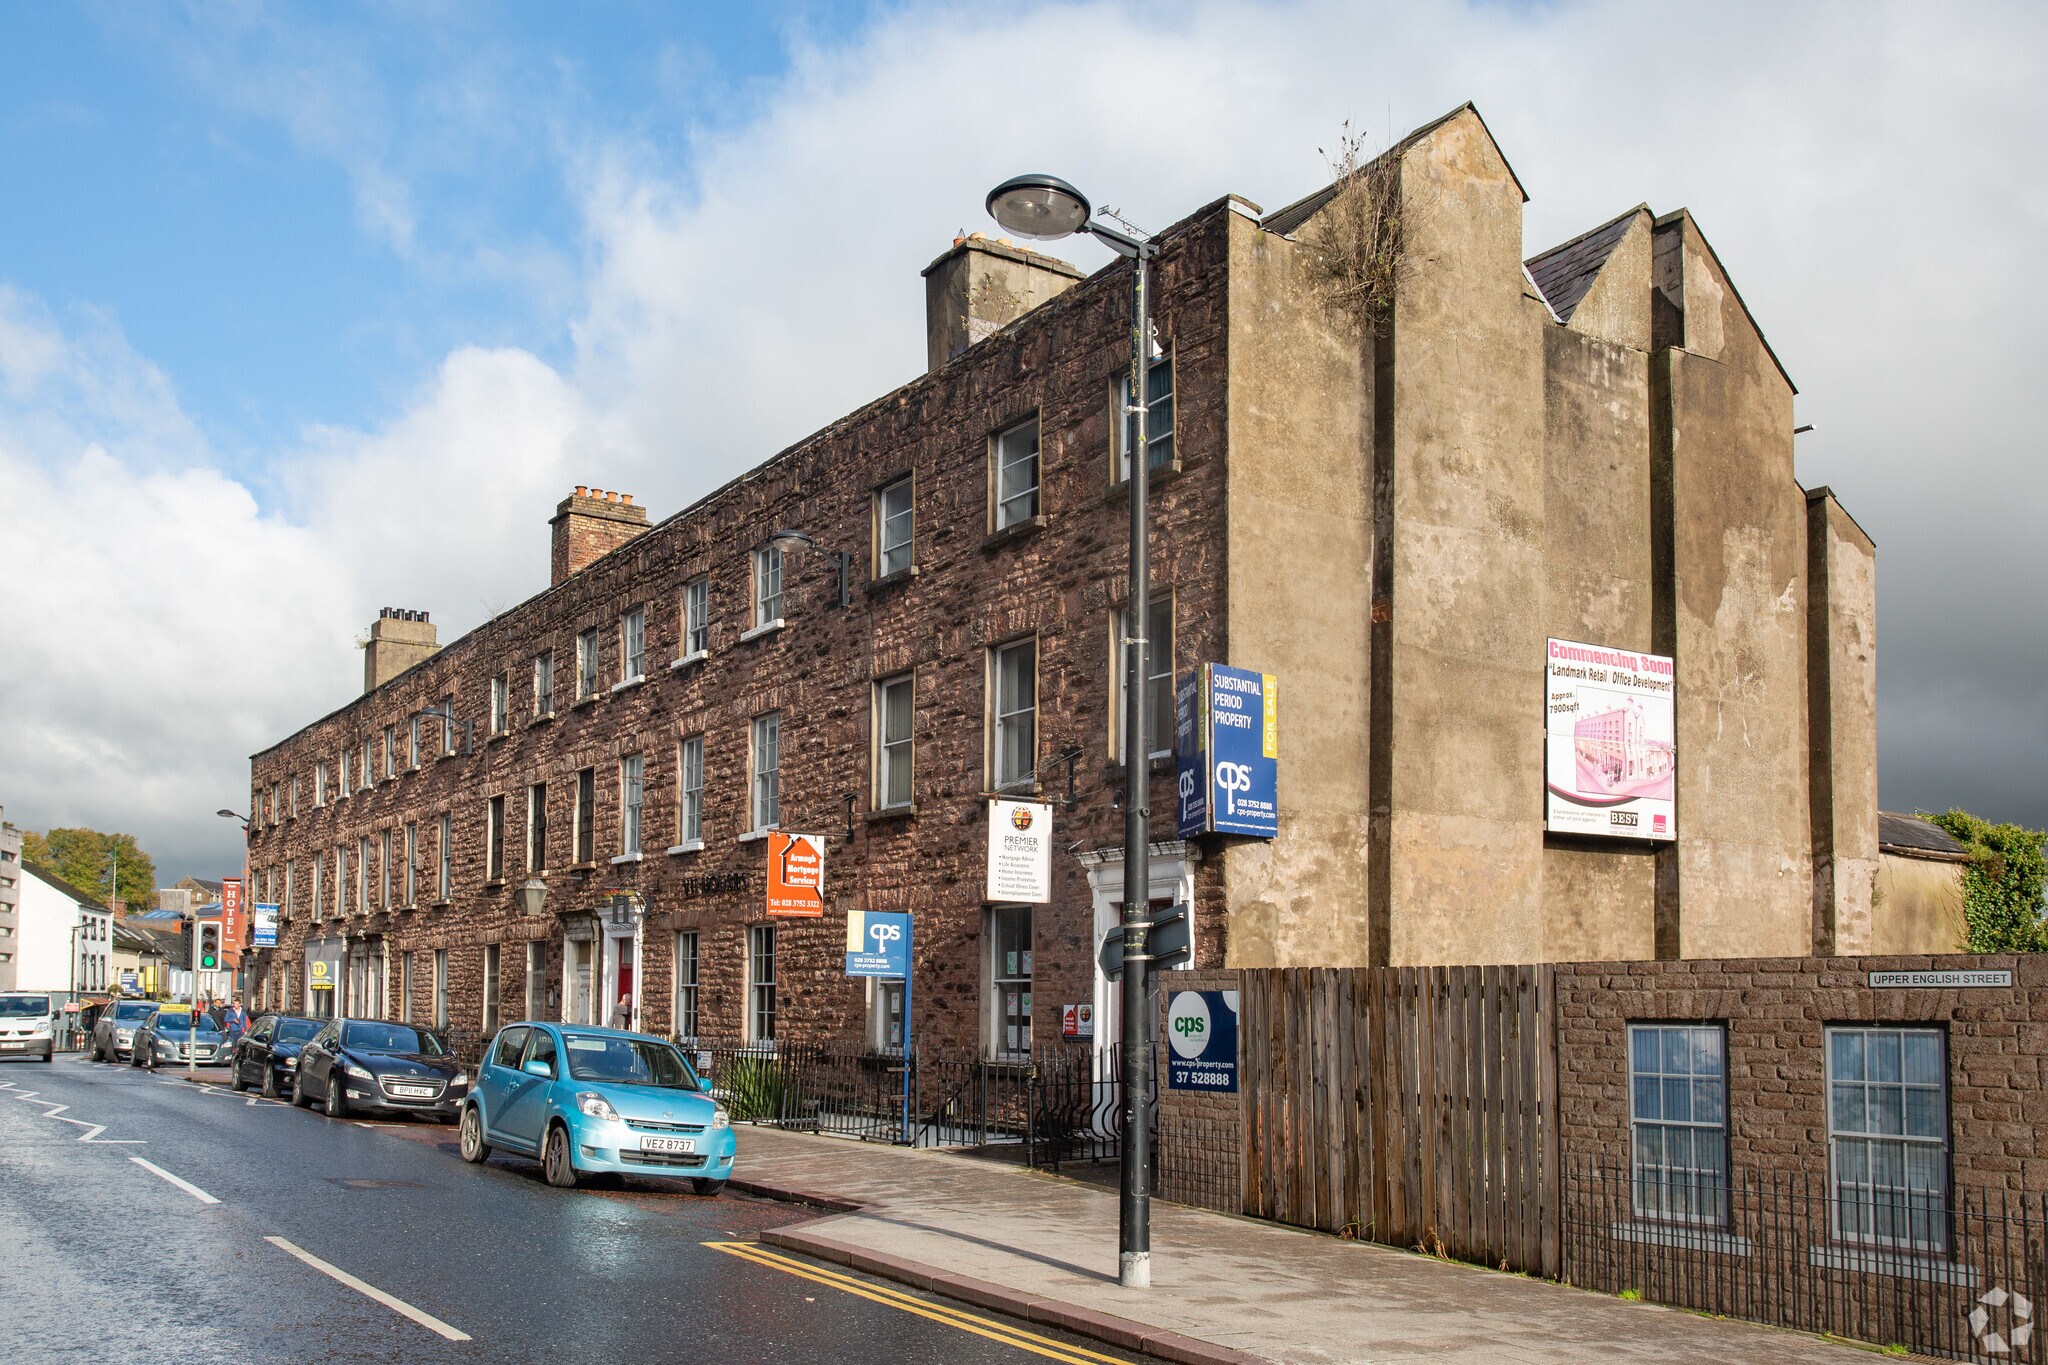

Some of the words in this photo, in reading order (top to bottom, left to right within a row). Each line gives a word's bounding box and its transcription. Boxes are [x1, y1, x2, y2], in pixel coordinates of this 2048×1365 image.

[1549, 641, 1638, 672] Commencing
[1640, 656, 1672, 675] Soon
[1588, 668, 1608, 683] Retail
[1612, 672, 1632, 686] Office
[1214, 674, 1262, 696] SUBSTANTIAL
[1214, 692, 1243, 710] PERIOD
[1266, 680, 1275, 716] SALE
[1551, 691, 1575, 702] Approx.
[1549, 702, 1580, 714] 7900sqft
[1215, 711, 1252, 730] PROPERTY
[1266, 721, 1275, 751] FOR
[1237, 798, 1248, 807] 028
[1248, 799, 1260, 809] 3752
[1236, 808, 1276, 820] cps-property.com
[1610, 812, 1638, 826] BEST
[1004, 835, 1039, 846] PREMIER
[1004, 844, 1039, 853] NETWORK
[790, 853, 817, 864] Armagh
[787, 864, 819, 875] Mortgage
[789, 875, 817, 885] Services
[770, 898, 781, 907] Tel:
[781, 899, 792, 907] 028
[792, 899, 806, 907] 3752
[806, 900, 820, 908] 3322
[226, 890, 236, 935] HOTEL
[870, 923, 901, 954] cps
[1874, 975, 1909, 984] UPPER
[1913, 974, 1960, 984] ENGLISH
[1963, 974, 2007, 984] STREET
[1174, 1016, 1205, 1037] cps
[1171, 1060, 1235, 1070] www.cps-property.com
[1176, 1071, 1189, 1084] 37
[1191, 1071, 1230, 1086] 528888
[646, 1138, 665, 1149] VEZ
[666, 1139, 691, 1151] 8737
